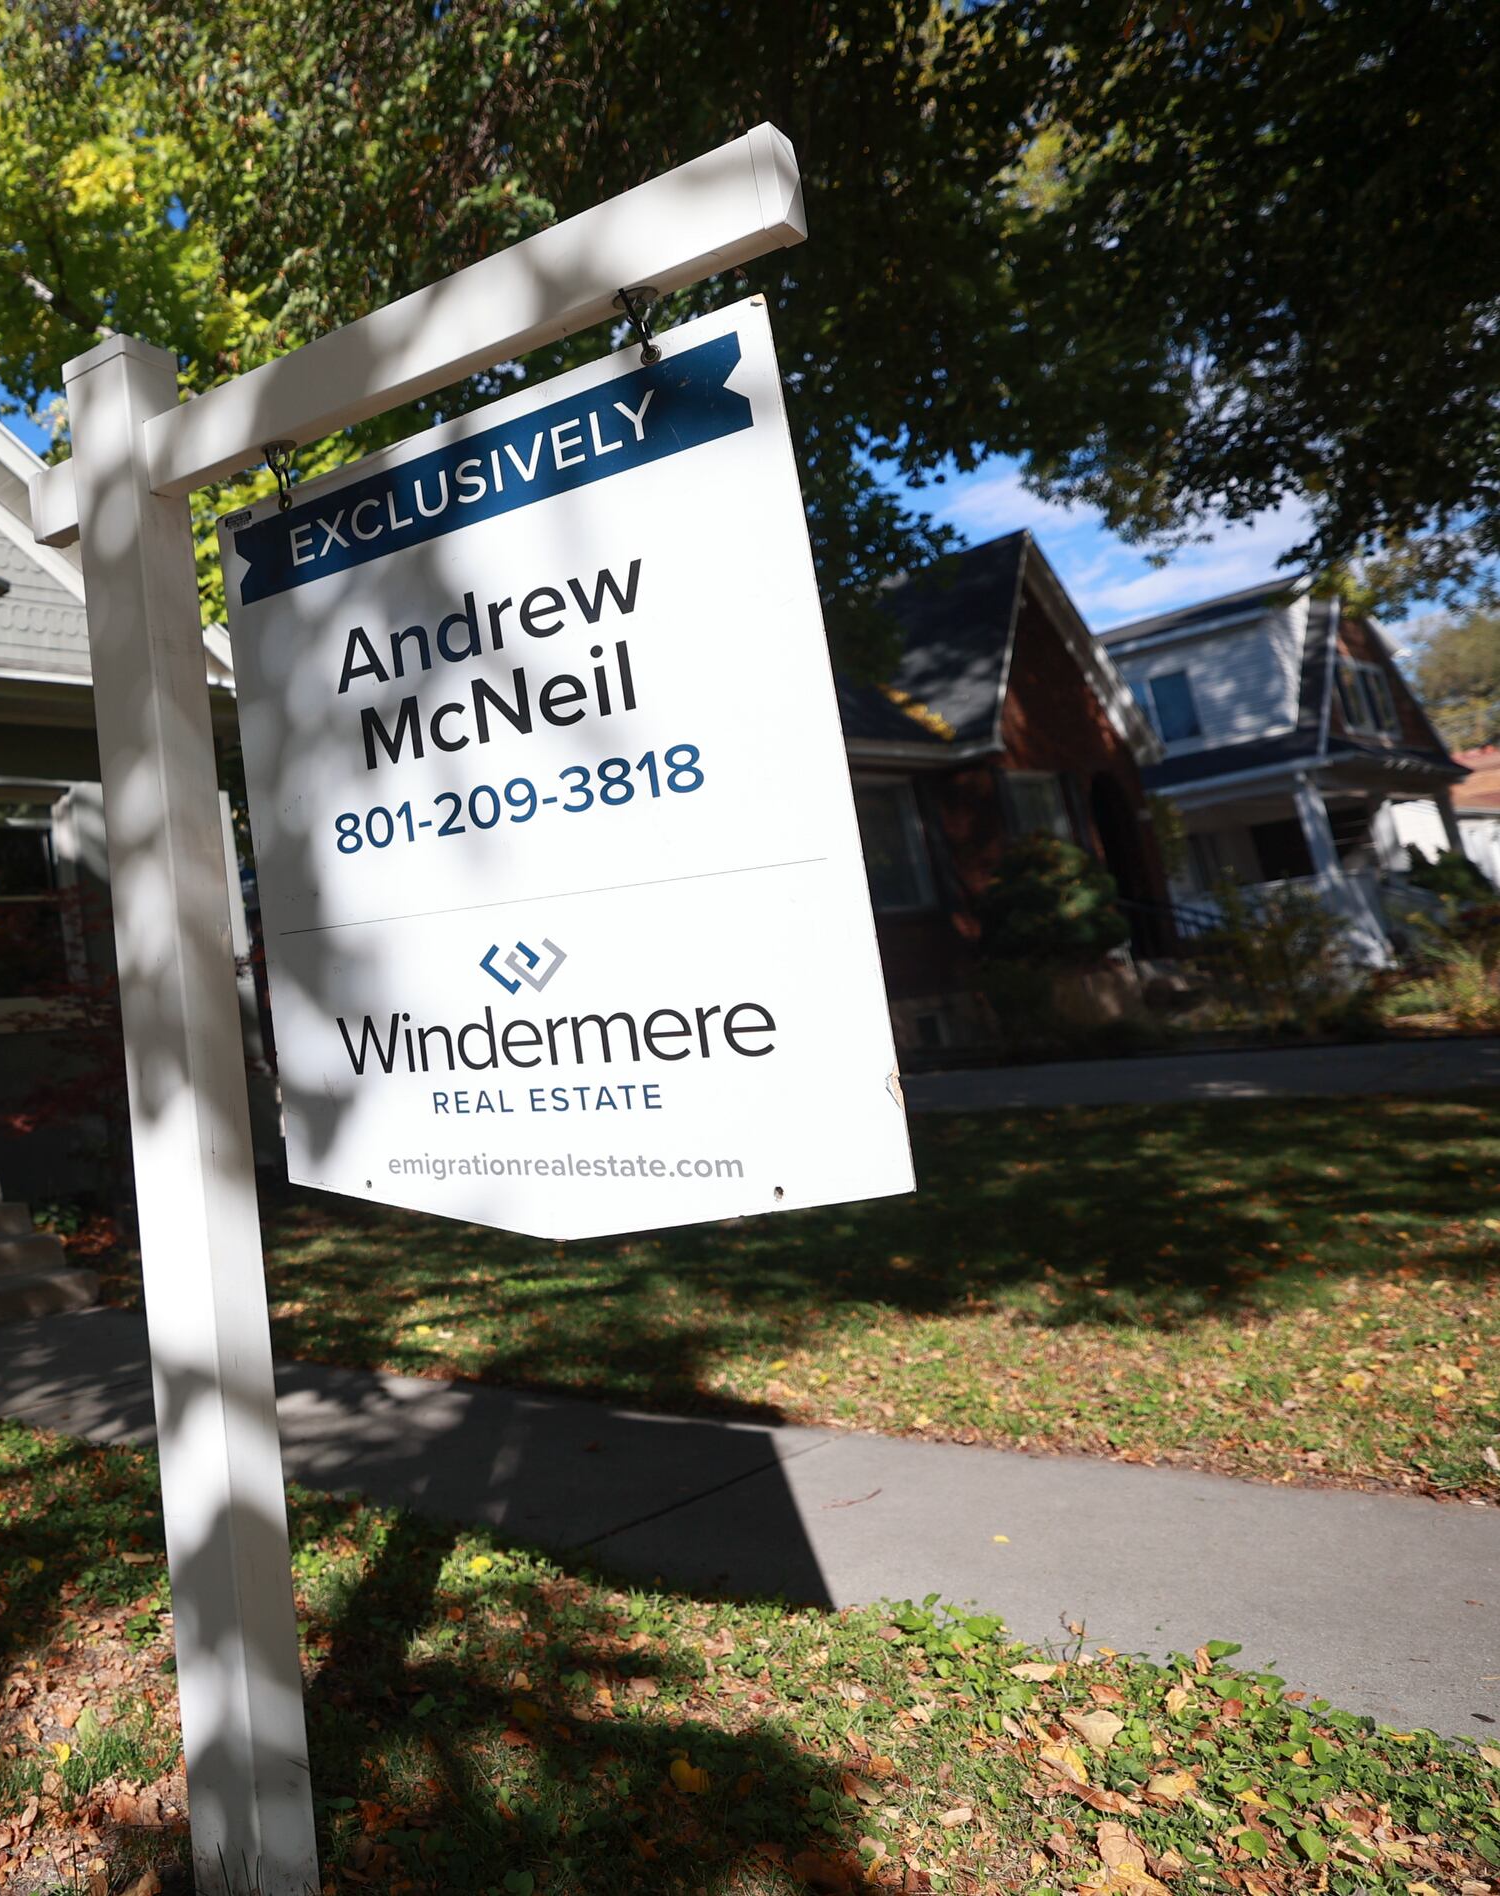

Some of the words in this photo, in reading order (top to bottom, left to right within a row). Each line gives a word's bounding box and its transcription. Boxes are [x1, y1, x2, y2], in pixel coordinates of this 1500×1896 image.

[289, 389, 656, 567] EXCLUSIVELY
[337, 558, 642, 694] Andrew
[359, 640, 637, 771] McNeil
[334, 743, 705, 855] 801-209-3818
[336, 1002, 777, 1076] Windermere
[432, 1089, 515, 1115] REAL
[528, 1083, 663, 1113] ESTATE
[387, 1153, 744, 1181] emigrationrealestate.com
